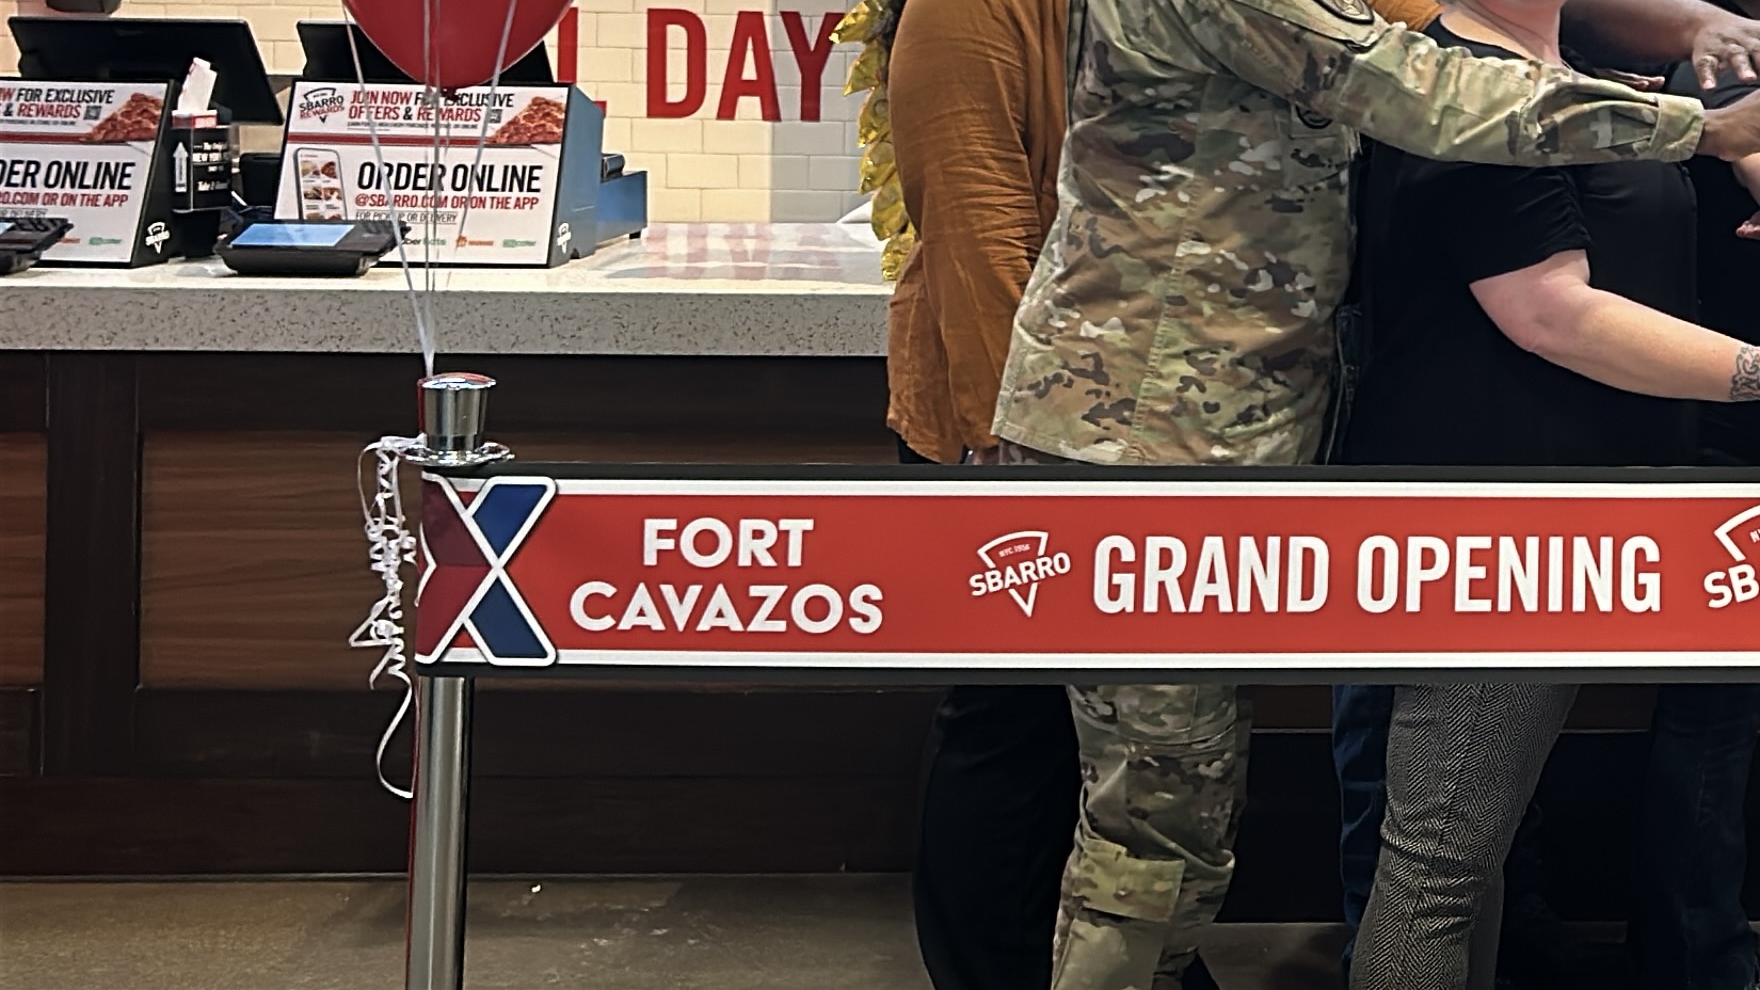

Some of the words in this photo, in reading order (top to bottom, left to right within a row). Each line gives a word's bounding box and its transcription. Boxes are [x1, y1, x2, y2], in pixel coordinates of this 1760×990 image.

[647, 8, 845, 122] DAY
[16, 88, 44, 103] FOR
[45, 89, 115, 104] EXCLUSIVE
[299, 95, 344, 110] SBARRO
[381, 92, 413, 105] NOW
[4, 103, 13, 116] &
[17, 104, 82, 118] REWARDS
[300, 105, 345, 119] REWARDS
[403, 108, 413, 121] &
[44, 161, 135, 190] ONLINE
[357, 162, 446, 191] ORDER
[451, 164, 543, 193] ONLINE
[42, 192, 58, 205] OR
[60, 193, 78, 206] ON
[81, 194, 104, 207] THE
[105, 194, 128, 207] APP
[470, 197, 488, 209] ON
[490, 197, 512, 210] THE
[513, 197, 539, 210] APP
[640, 517, 816, 569] FORT
[969, 552, 1071, 596] SBARRO
[1091, 533, 1334, 617] GRAND
[1354, 534, 1663, 617] OPENING
[567, 581, 885, 636] CAVAZOS
